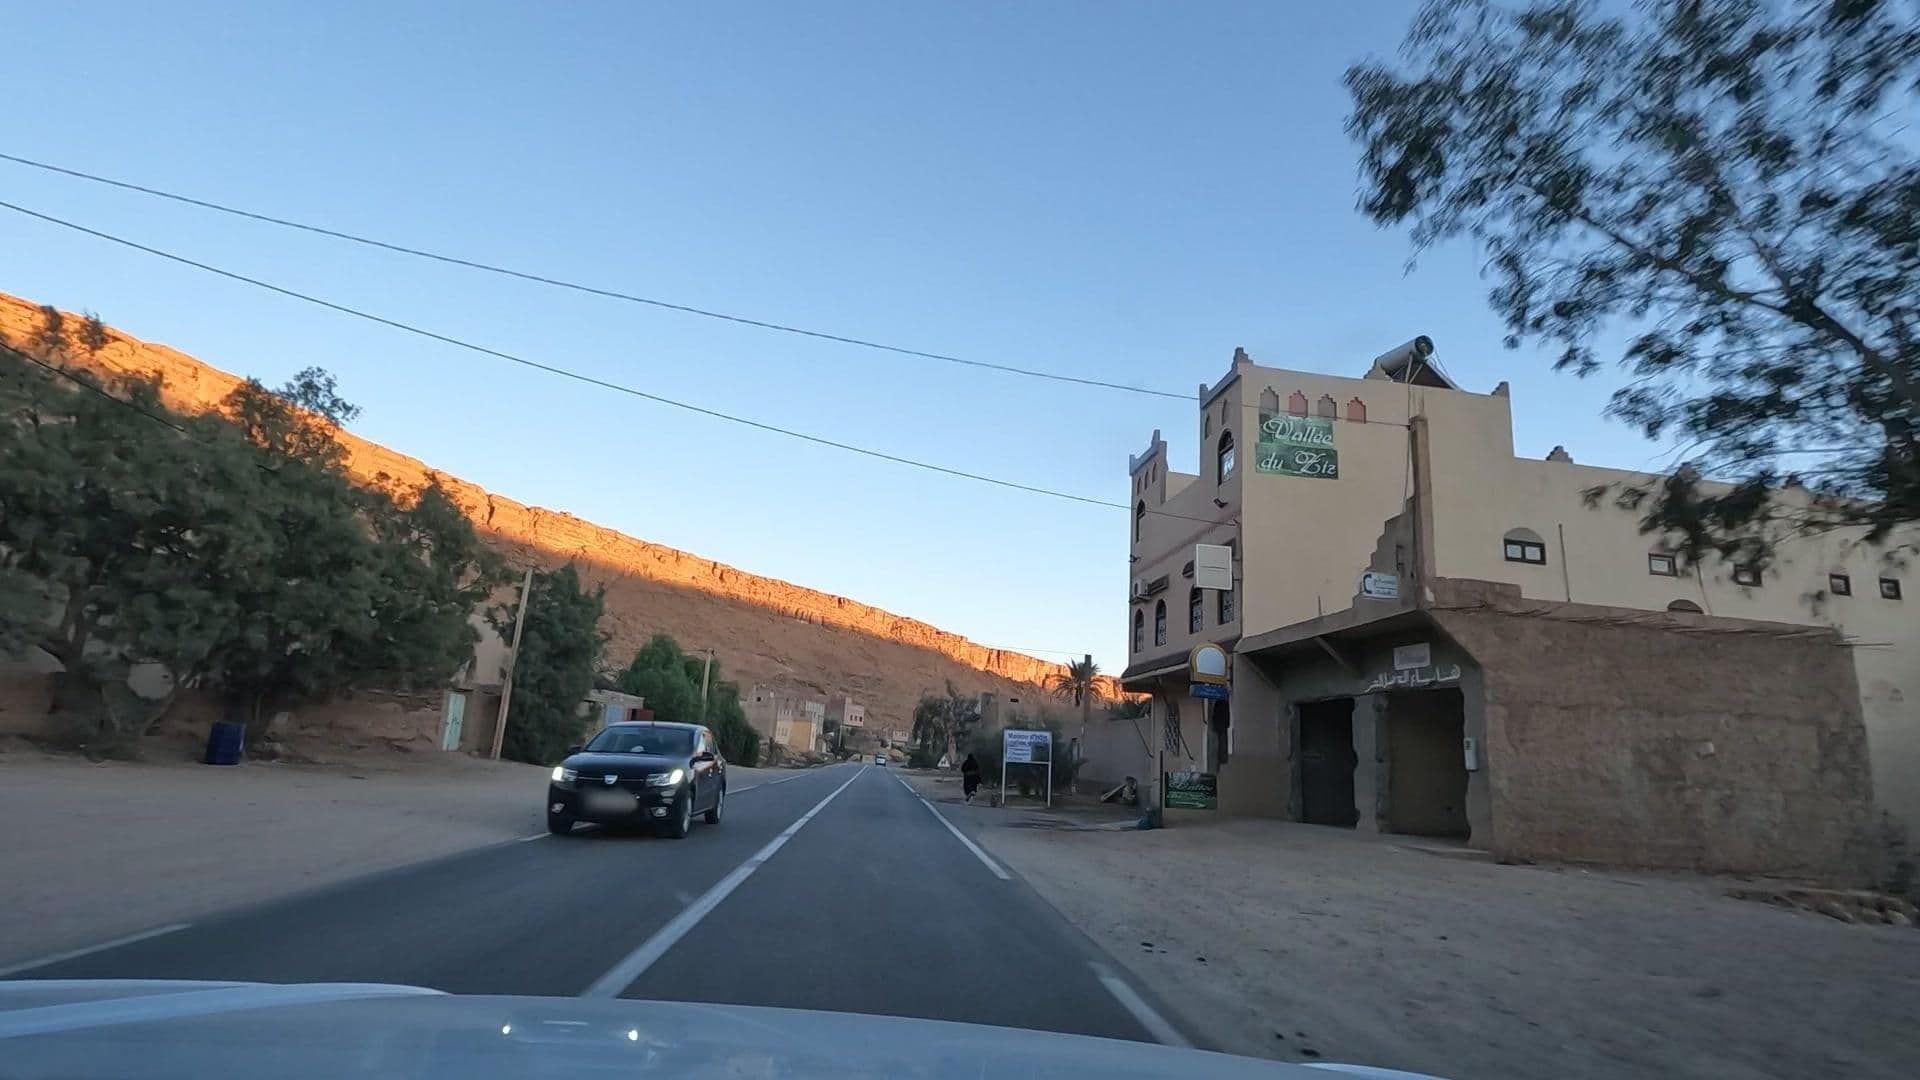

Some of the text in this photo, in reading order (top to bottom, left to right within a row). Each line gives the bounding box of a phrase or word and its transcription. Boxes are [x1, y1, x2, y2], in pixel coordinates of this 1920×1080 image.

[1263, 418, 1333, 446] Vallée
[1260, 450, 1337, 475] du Ziz
